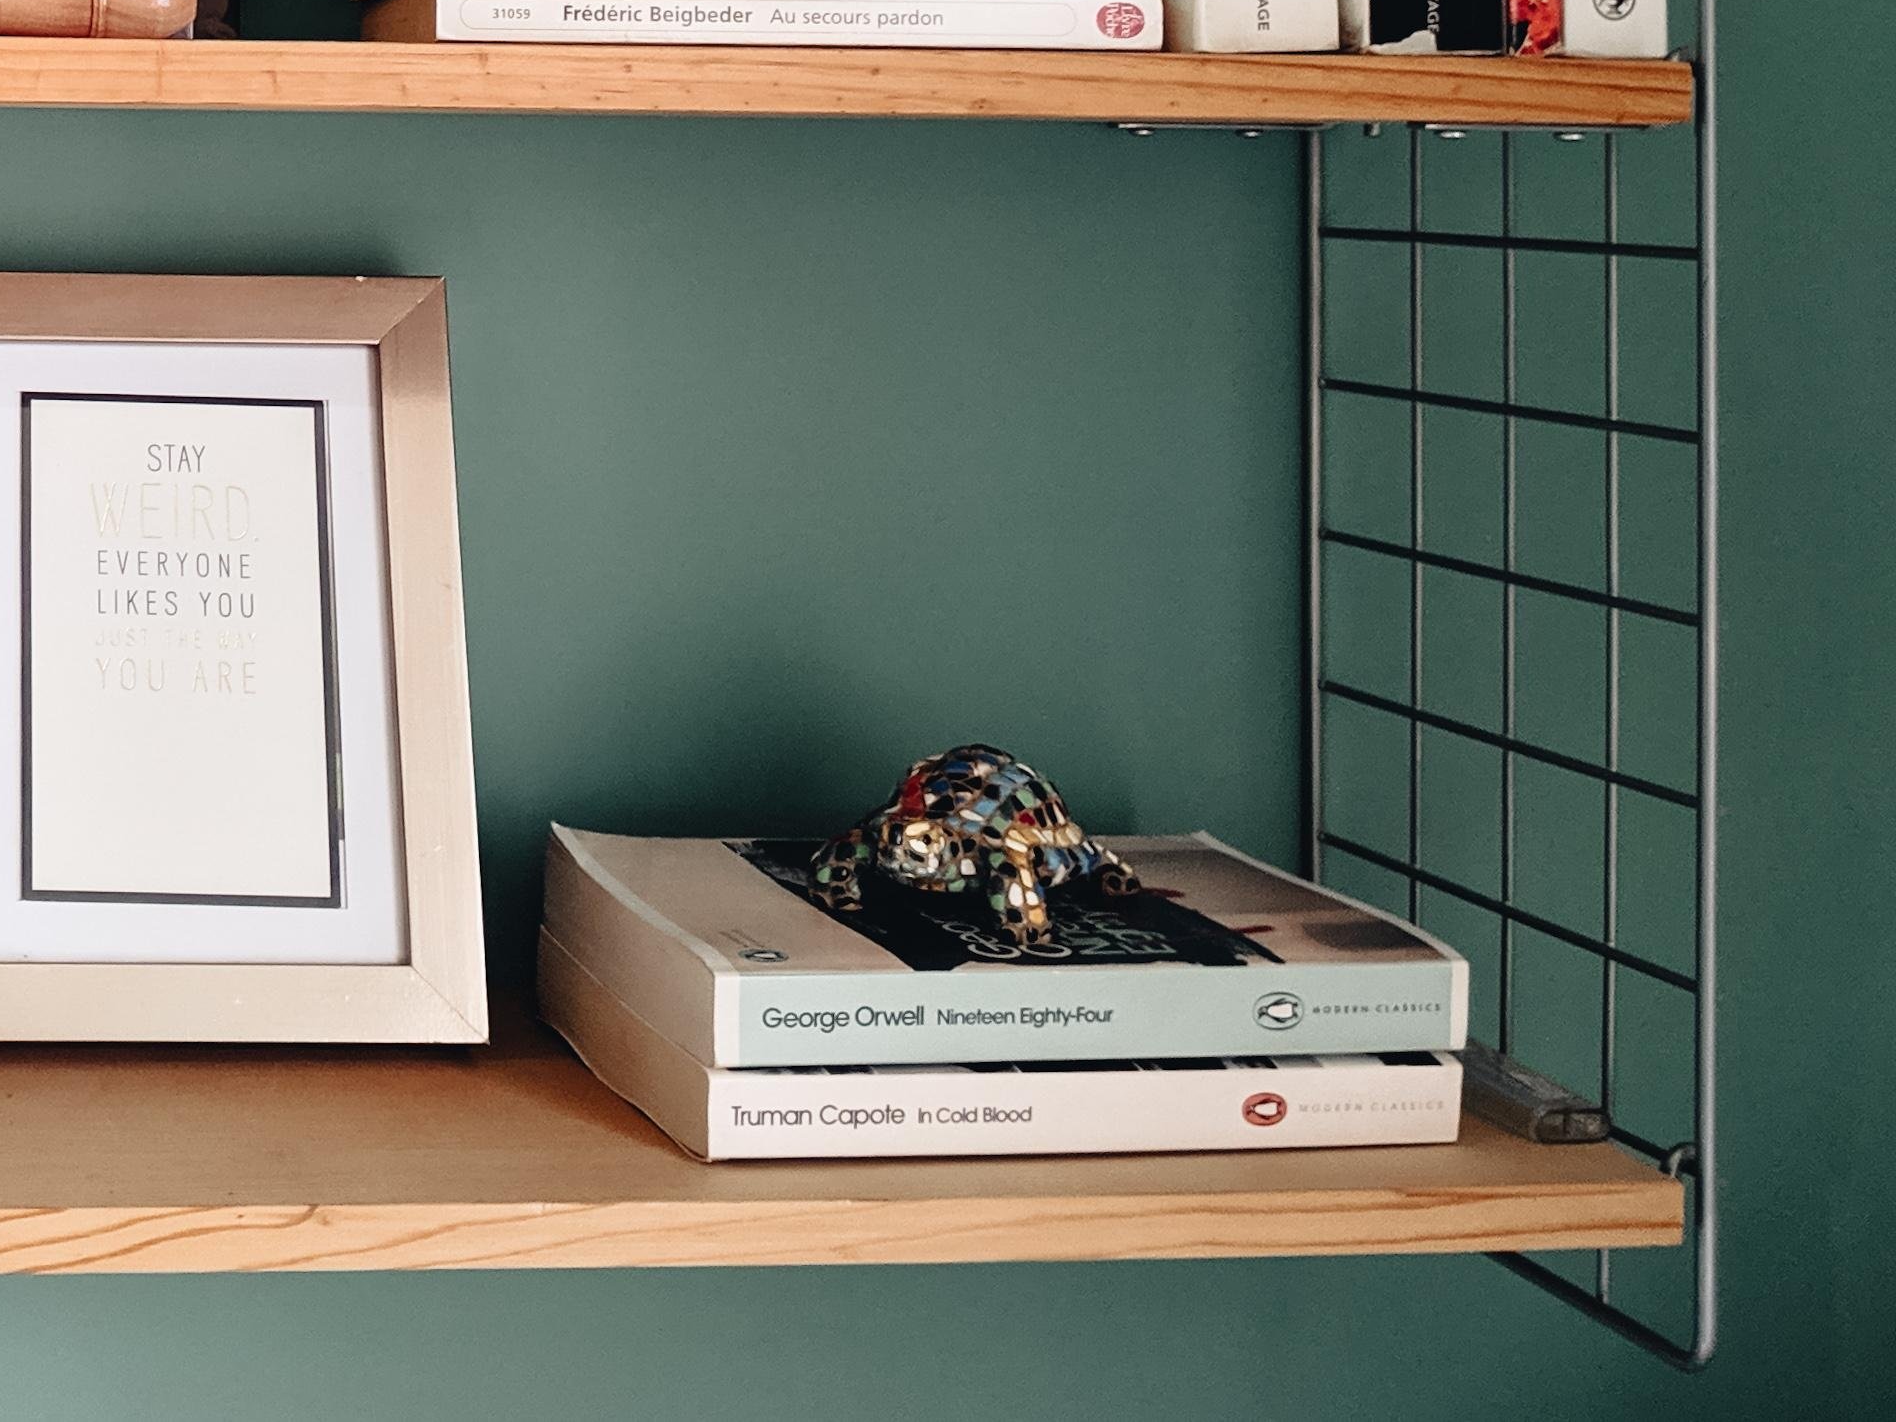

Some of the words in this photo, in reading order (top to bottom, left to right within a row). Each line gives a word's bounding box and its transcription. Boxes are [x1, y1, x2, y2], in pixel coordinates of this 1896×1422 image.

[492, 7, 531, 20] 31059
[563, 3, 643, 24] Frédéric
[650, 5, 753, 29] Beigbeder
[770, 10, 796, 25] Au
[802, 13, 871, 27] secours
[877, 10, 944, 30] pardon
[147, 444, 205, 473] STAY
[90, 482, 259, 541] WEIRD.
[97, 550, 252, 579] EVERYONE
[97, 589, 178, 616] LIKES
[199, 591, 254, 618] YOU
[95, 658, 165, 692] YOU
[193, 660, 257, 695] ARE
[762, 1007, 850, 1033] George
[854, 1005, 925, 1027] Orwell
[937, 1007, 1015, 1025] Nineteen
[1020, 1005, 1114, 1028] Eighty-Four
[1313, 1005, 1369, 1014] MODERN
[1375, 1003, 1441, 1013] CLASSICS
[731, 1105, 813, 1127] Truman
[819, 1105, 905, 1129] Capote
[918, 1108, 932, 1124] In
[936, 1107, 979, 1123] Cold
[983, 1106, 1033, 1123] Blood
